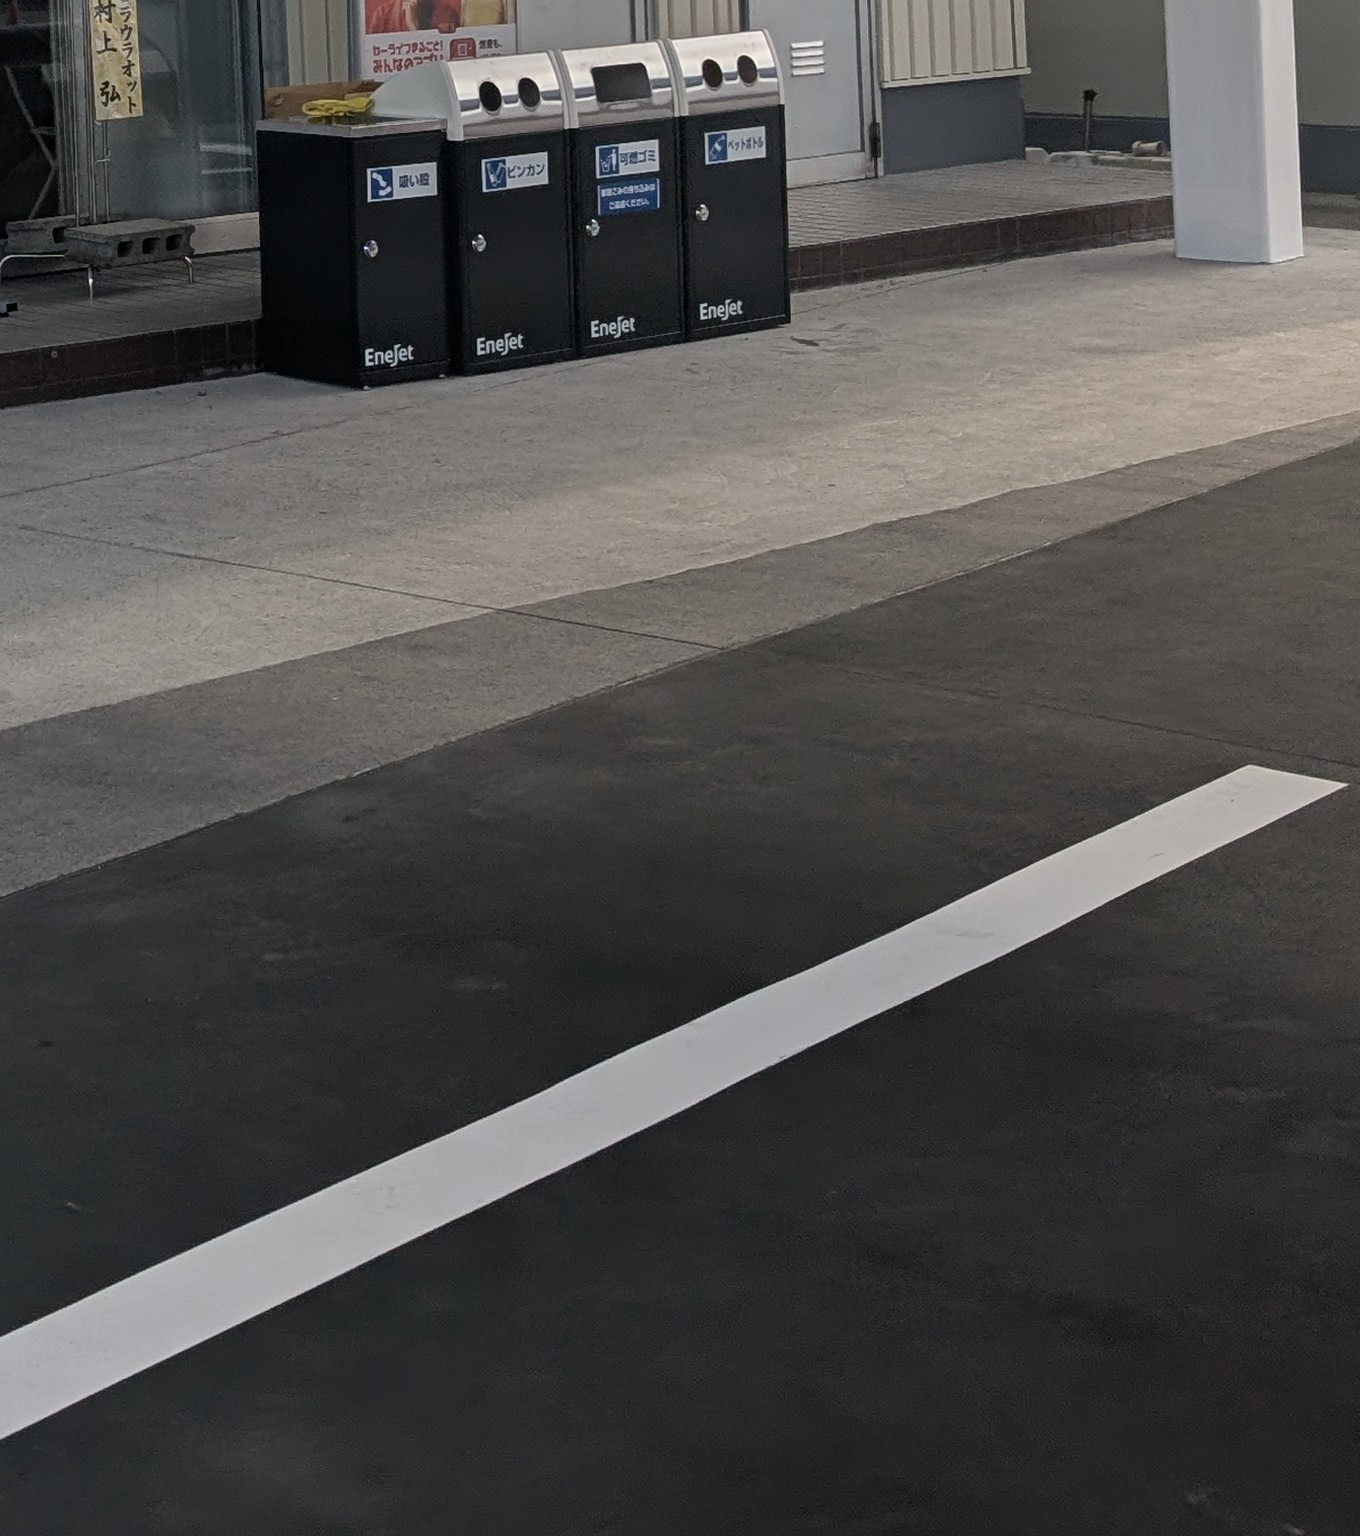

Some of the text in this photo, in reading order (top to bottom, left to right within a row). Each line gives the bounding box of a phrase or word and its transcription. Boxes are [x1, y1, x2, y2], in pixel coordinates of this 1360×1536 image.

[728, 136, 764, 151] ペットボトル
[620, 150, 656, 166] 可燃ゴミ
[507, 164, 545, 179] ビンカン
[699, 297, 743, 321] EneJet
[590, 315, 635, 339] EneJet
[364, 344, 414, 367] EneJet
[476, 332, 524, 356] EneJet
